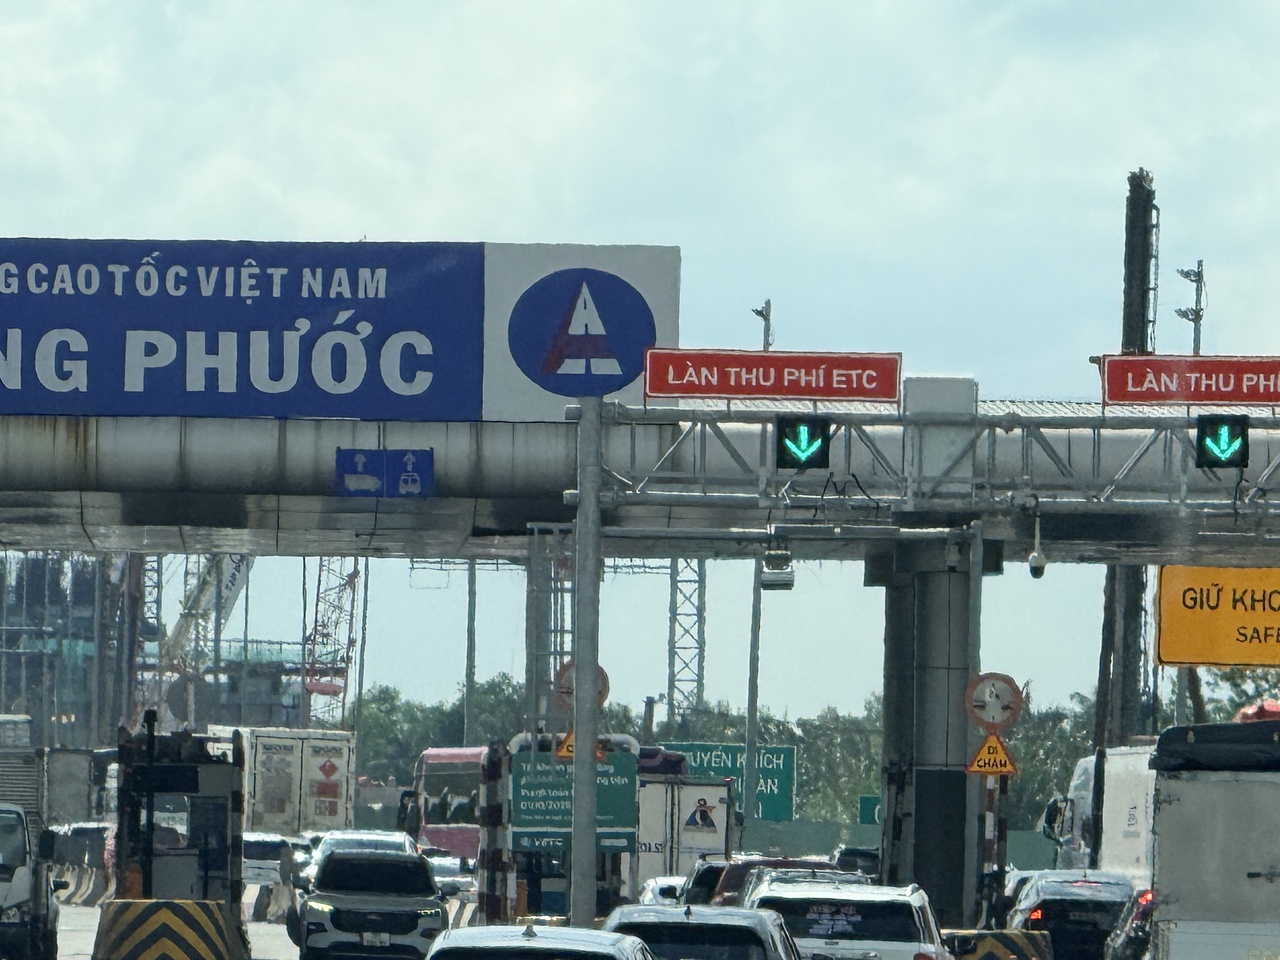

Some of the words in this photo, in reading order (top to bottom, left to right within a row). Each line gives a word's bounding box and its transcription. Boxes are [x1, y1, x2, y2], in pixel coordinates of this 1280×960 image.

[26, 262, 101, 296] CAO
[106, 251, 188, 298] TỐC
[198, 258, 288, 304] VIỆT
[301, 266, 388, 299] NAM
[123, 309, 434, 396] PHƯỚC
[668, 361, 718, 386] LÀN
[725, 367, 775, 386] THU
[784, 364, 827, 388] PHÍ
[832, 369, 877, 389] ETC
[1127, 368, 1178, 392] LÀN
[1186, 373, 1235, 392] THU
[1182, 582, 1224, 611] GIỮ
